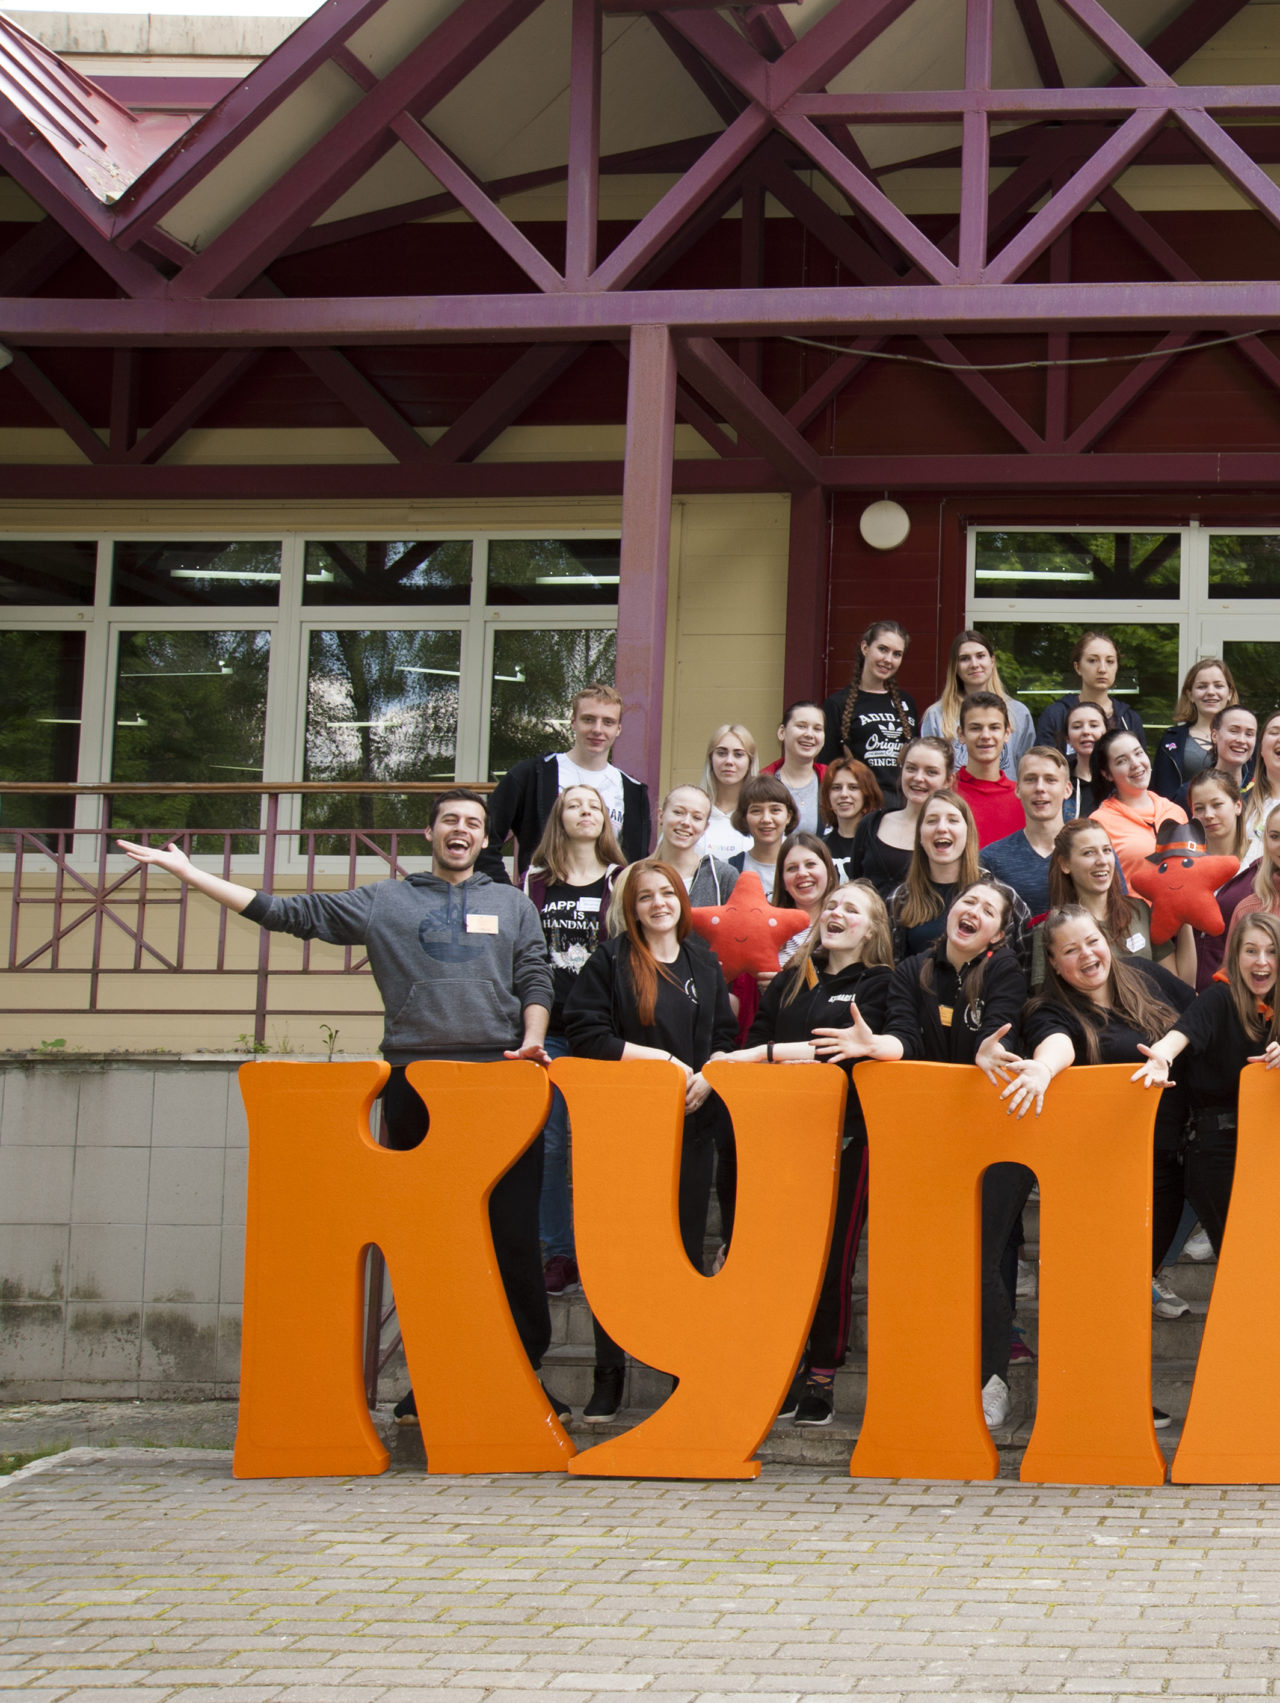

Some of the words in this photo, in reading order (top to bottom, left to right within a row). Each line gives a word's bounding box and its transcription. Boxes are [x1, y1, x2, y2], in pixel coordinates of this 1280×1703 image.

[859, 713, 915, 727] ADIDS
[868, 758, 898, 767] SINCE
[574, 911, 585, 920] IS
